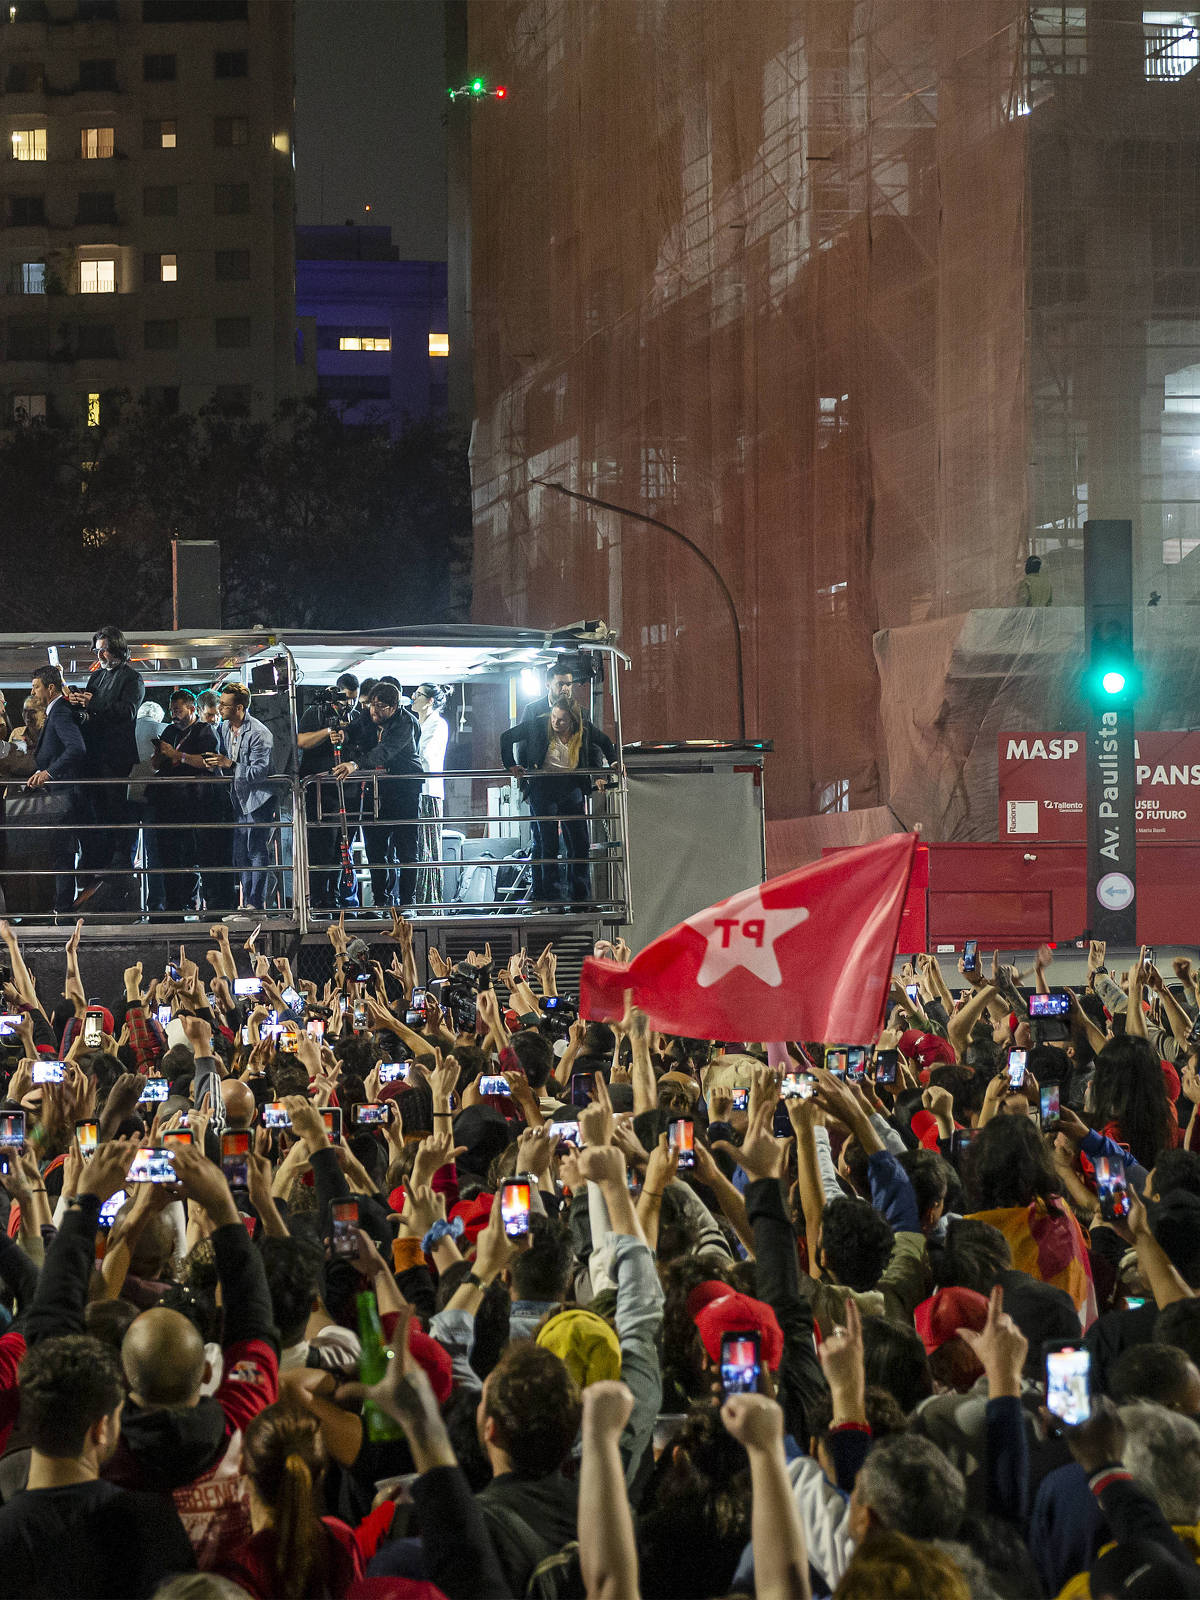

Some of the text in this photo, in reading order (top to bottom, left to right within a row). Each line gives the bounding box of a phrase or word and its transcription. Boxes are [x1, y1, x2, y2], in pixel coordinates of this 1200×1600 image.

[1006, 739, 1079, 760] MASP
[1098, 711, 1119, 861] Av. Paulista
[1146, 810, 1187, 820] FUTURO
